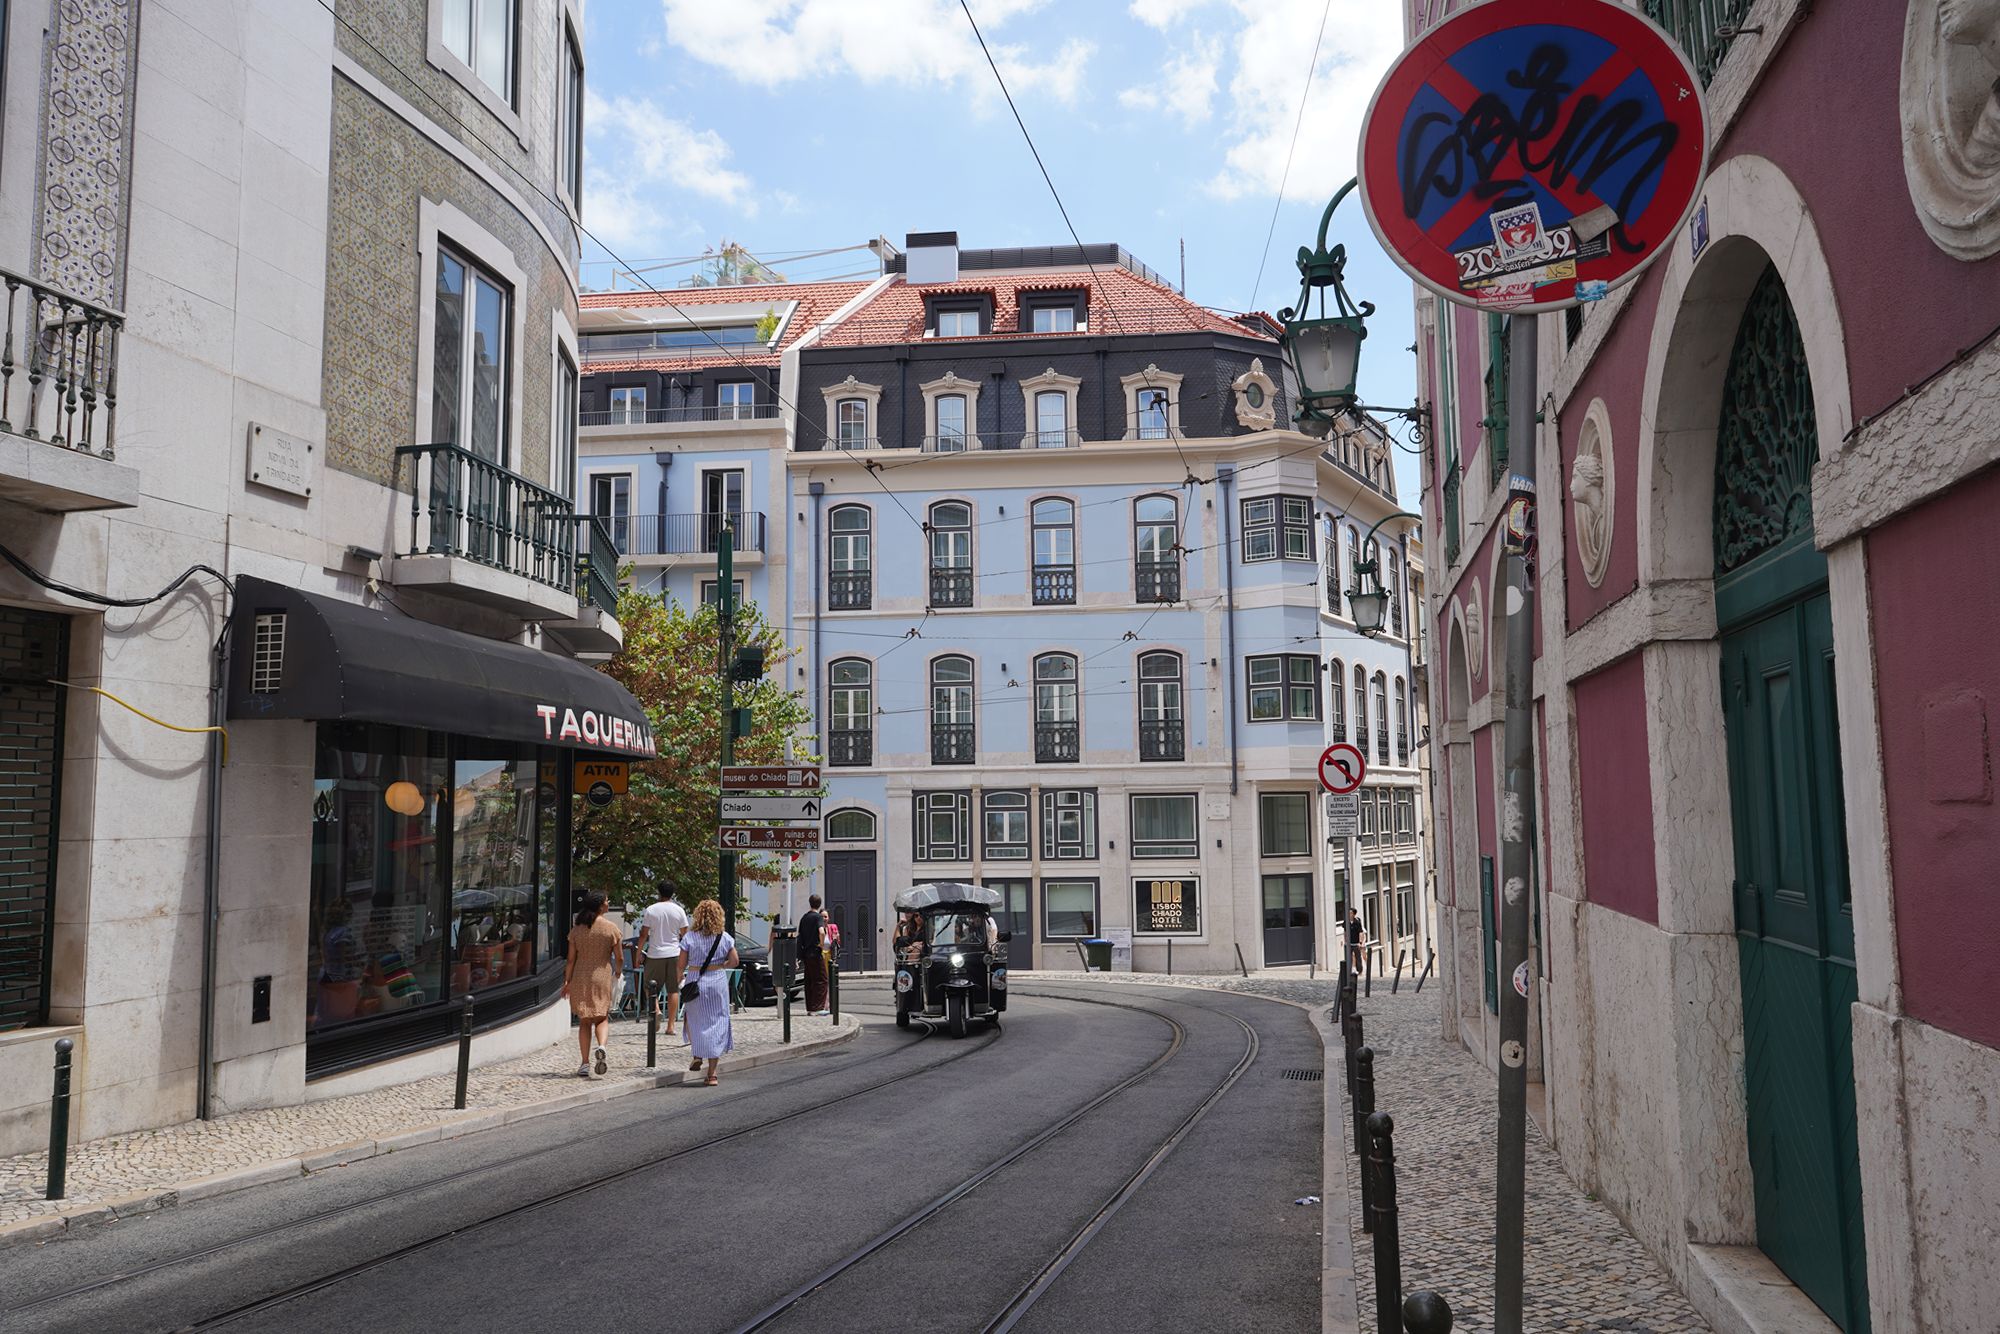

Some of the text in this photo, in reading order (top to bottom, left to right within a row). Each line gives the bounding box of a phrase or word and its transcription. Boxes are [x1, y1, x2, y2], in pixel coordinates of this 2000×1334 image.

[536, 704, 645, 754] TAQUERIA
[583, 765, 620, 776] ATM
[723, 772, 787, 782] museu do Chiado
[723, 802, 752, 812] Chiado
[784, 830, 817, 839] ruinas do
[783, 839, 792, 848] do
